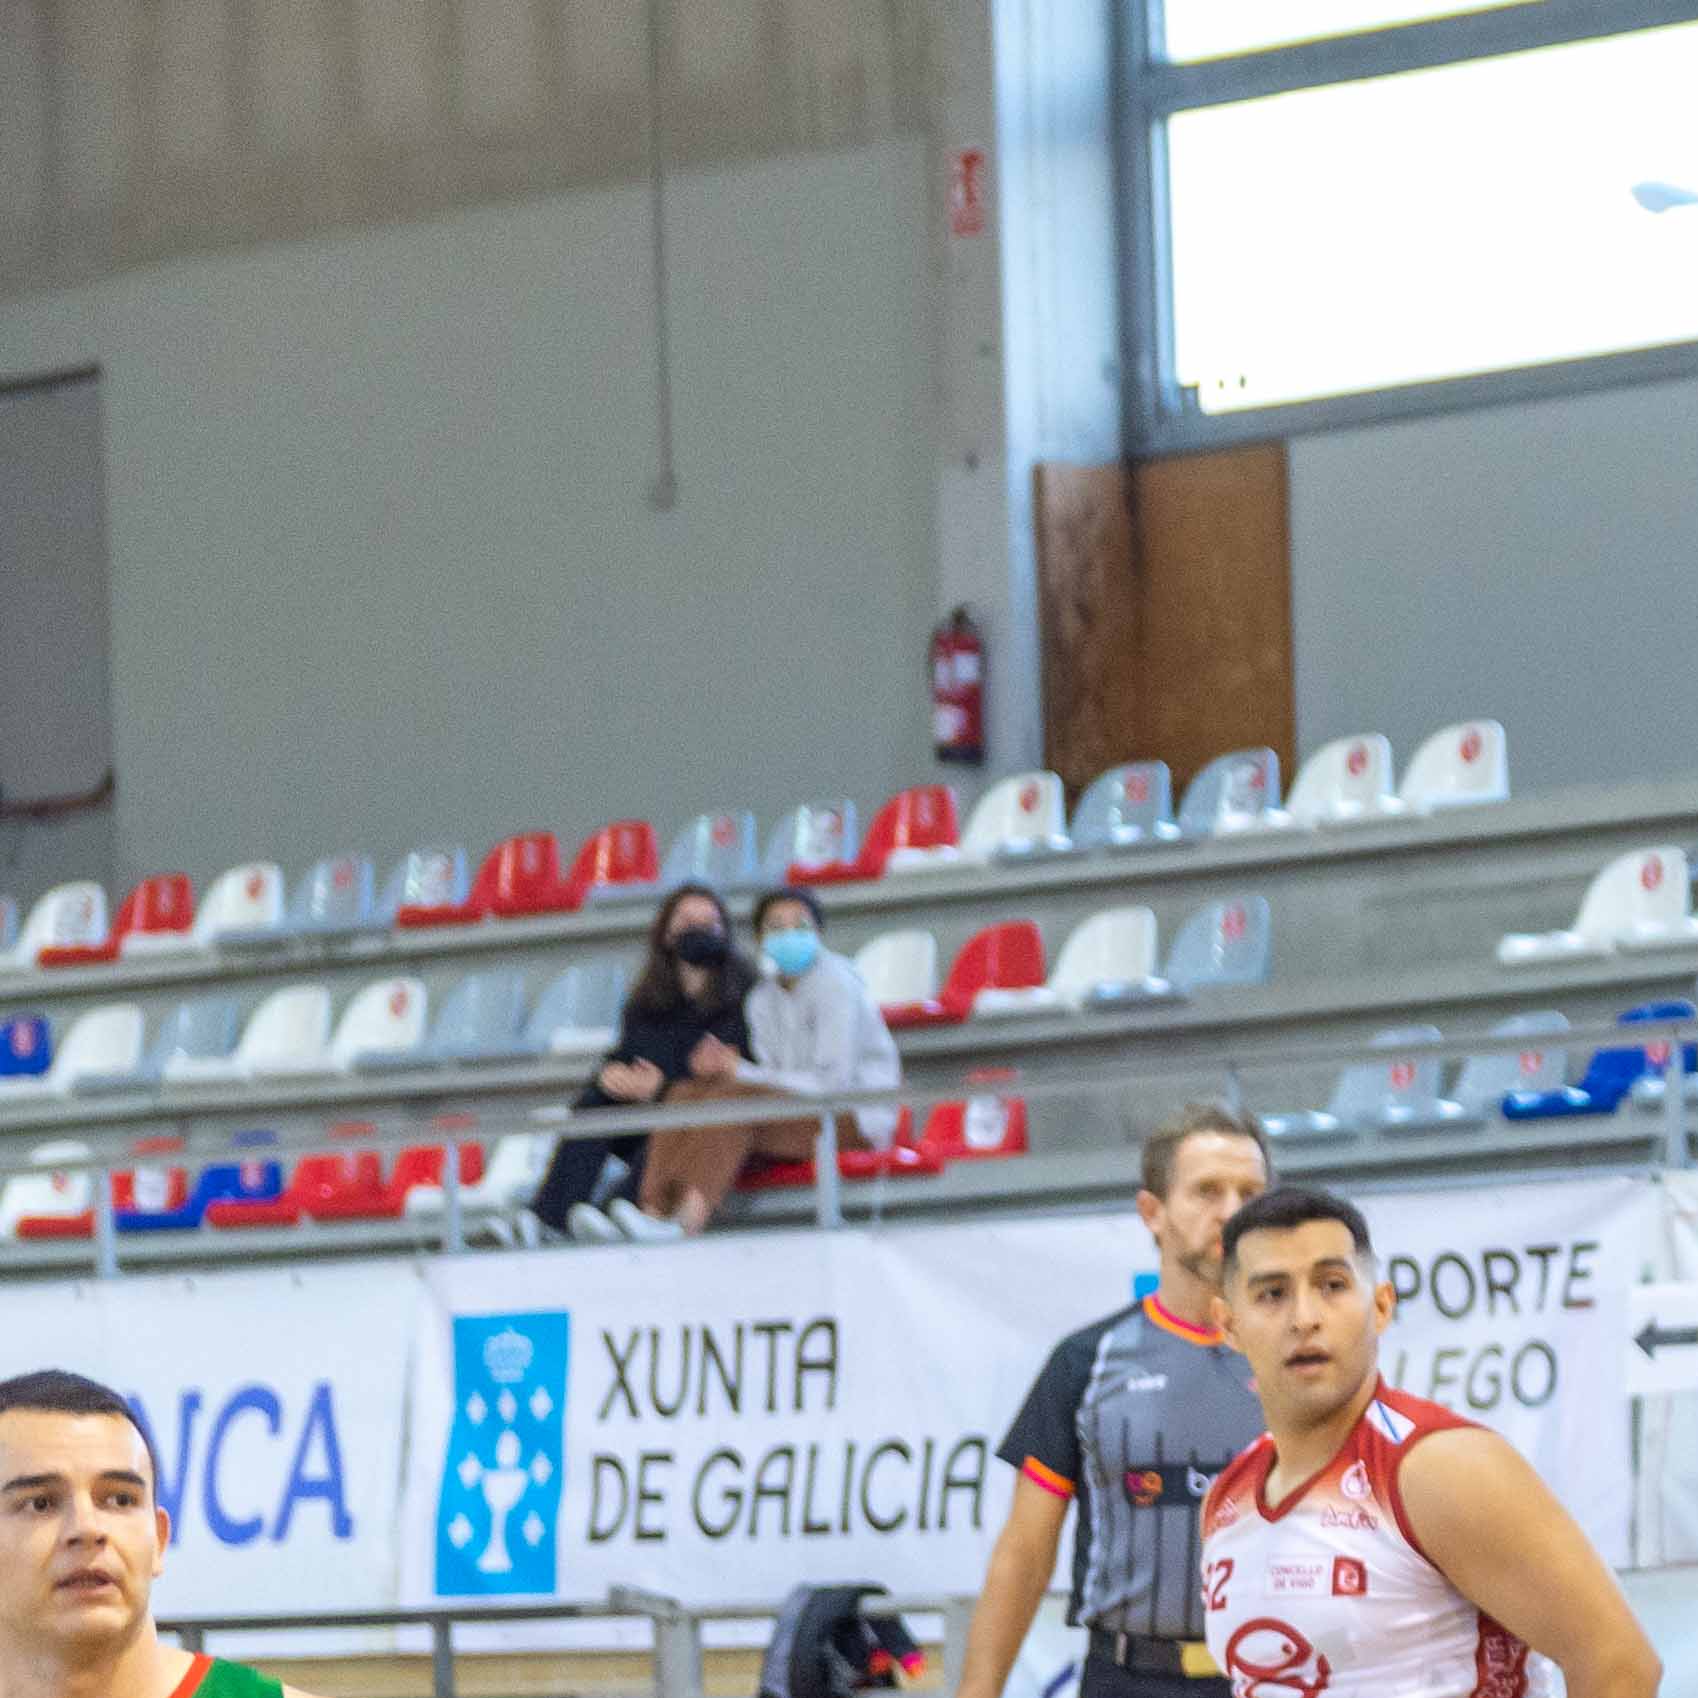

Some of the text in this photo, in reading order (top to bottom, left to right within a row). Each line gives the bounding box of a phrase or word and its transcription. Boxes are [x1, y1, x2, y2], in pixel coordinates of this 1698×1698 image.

[599, 1318, 838, 1420] XUNTA
[587, 1438, 986, 1544] DE GALICIA
